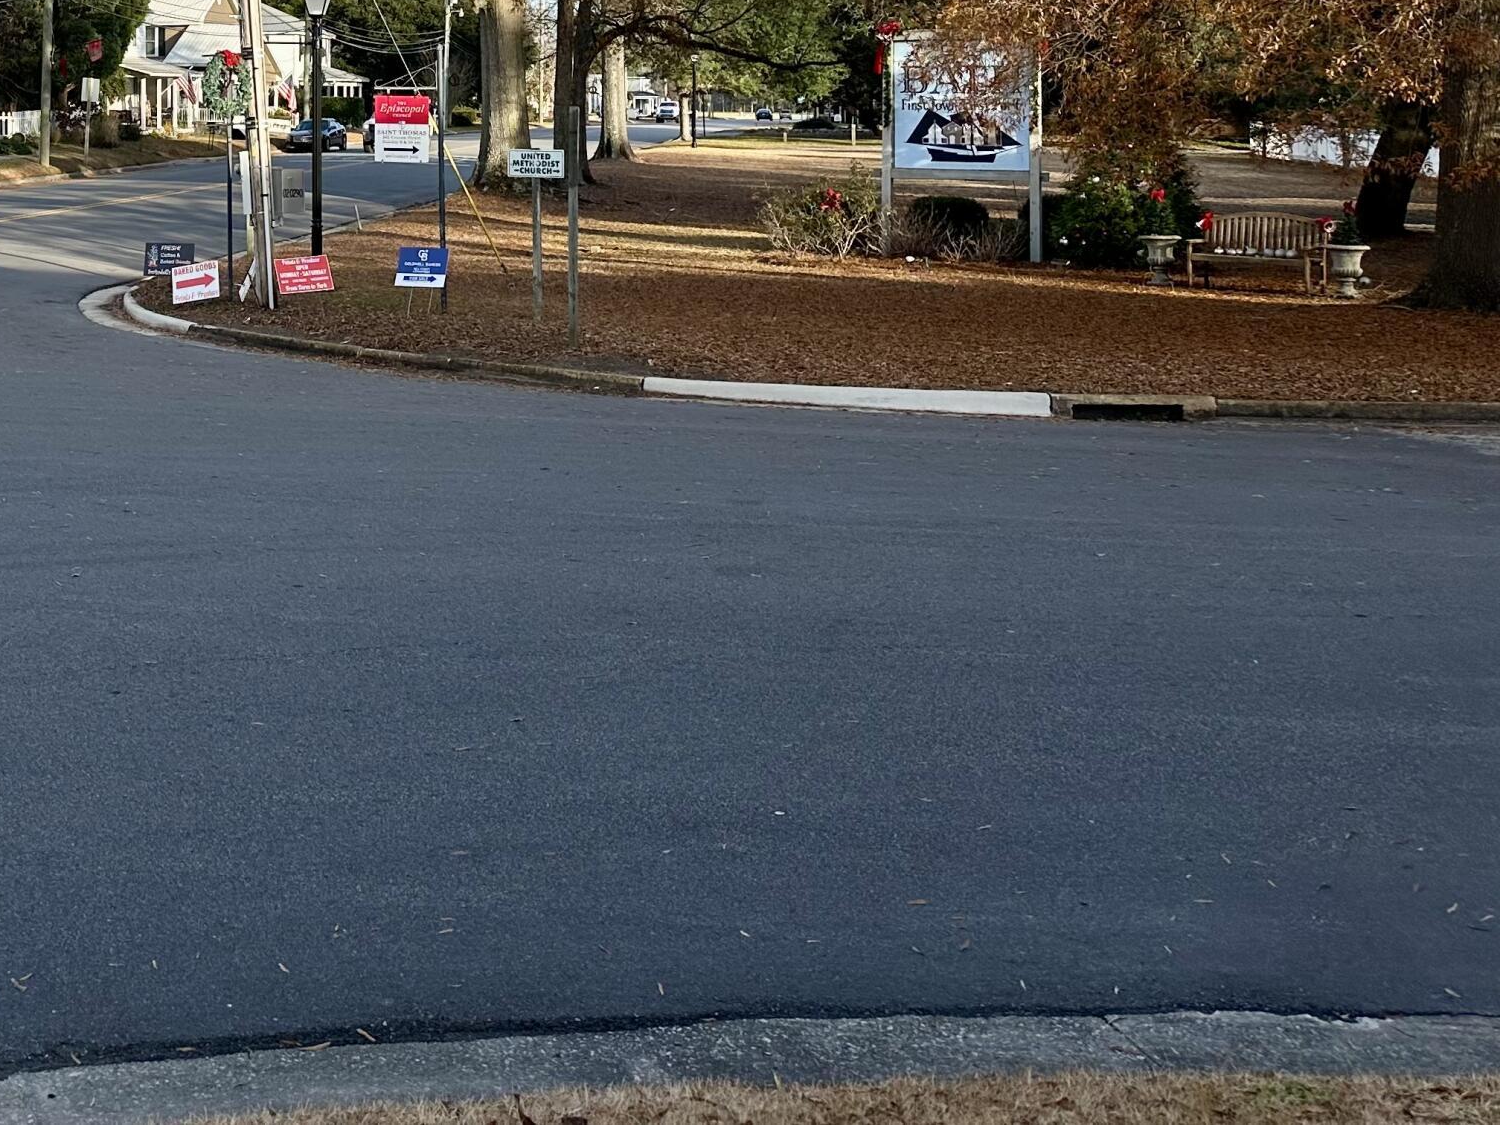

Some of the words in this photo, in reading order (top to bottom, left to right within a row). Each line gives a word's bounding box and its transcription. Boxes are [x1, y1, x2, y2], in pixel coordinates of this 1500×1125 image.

[380, 103, 425, 115] Episcopal
[520, 167, 552, 175] CHURCH
[173, 266, 194, 276] BAKED
[195, 261, 217, 273] GOODS
